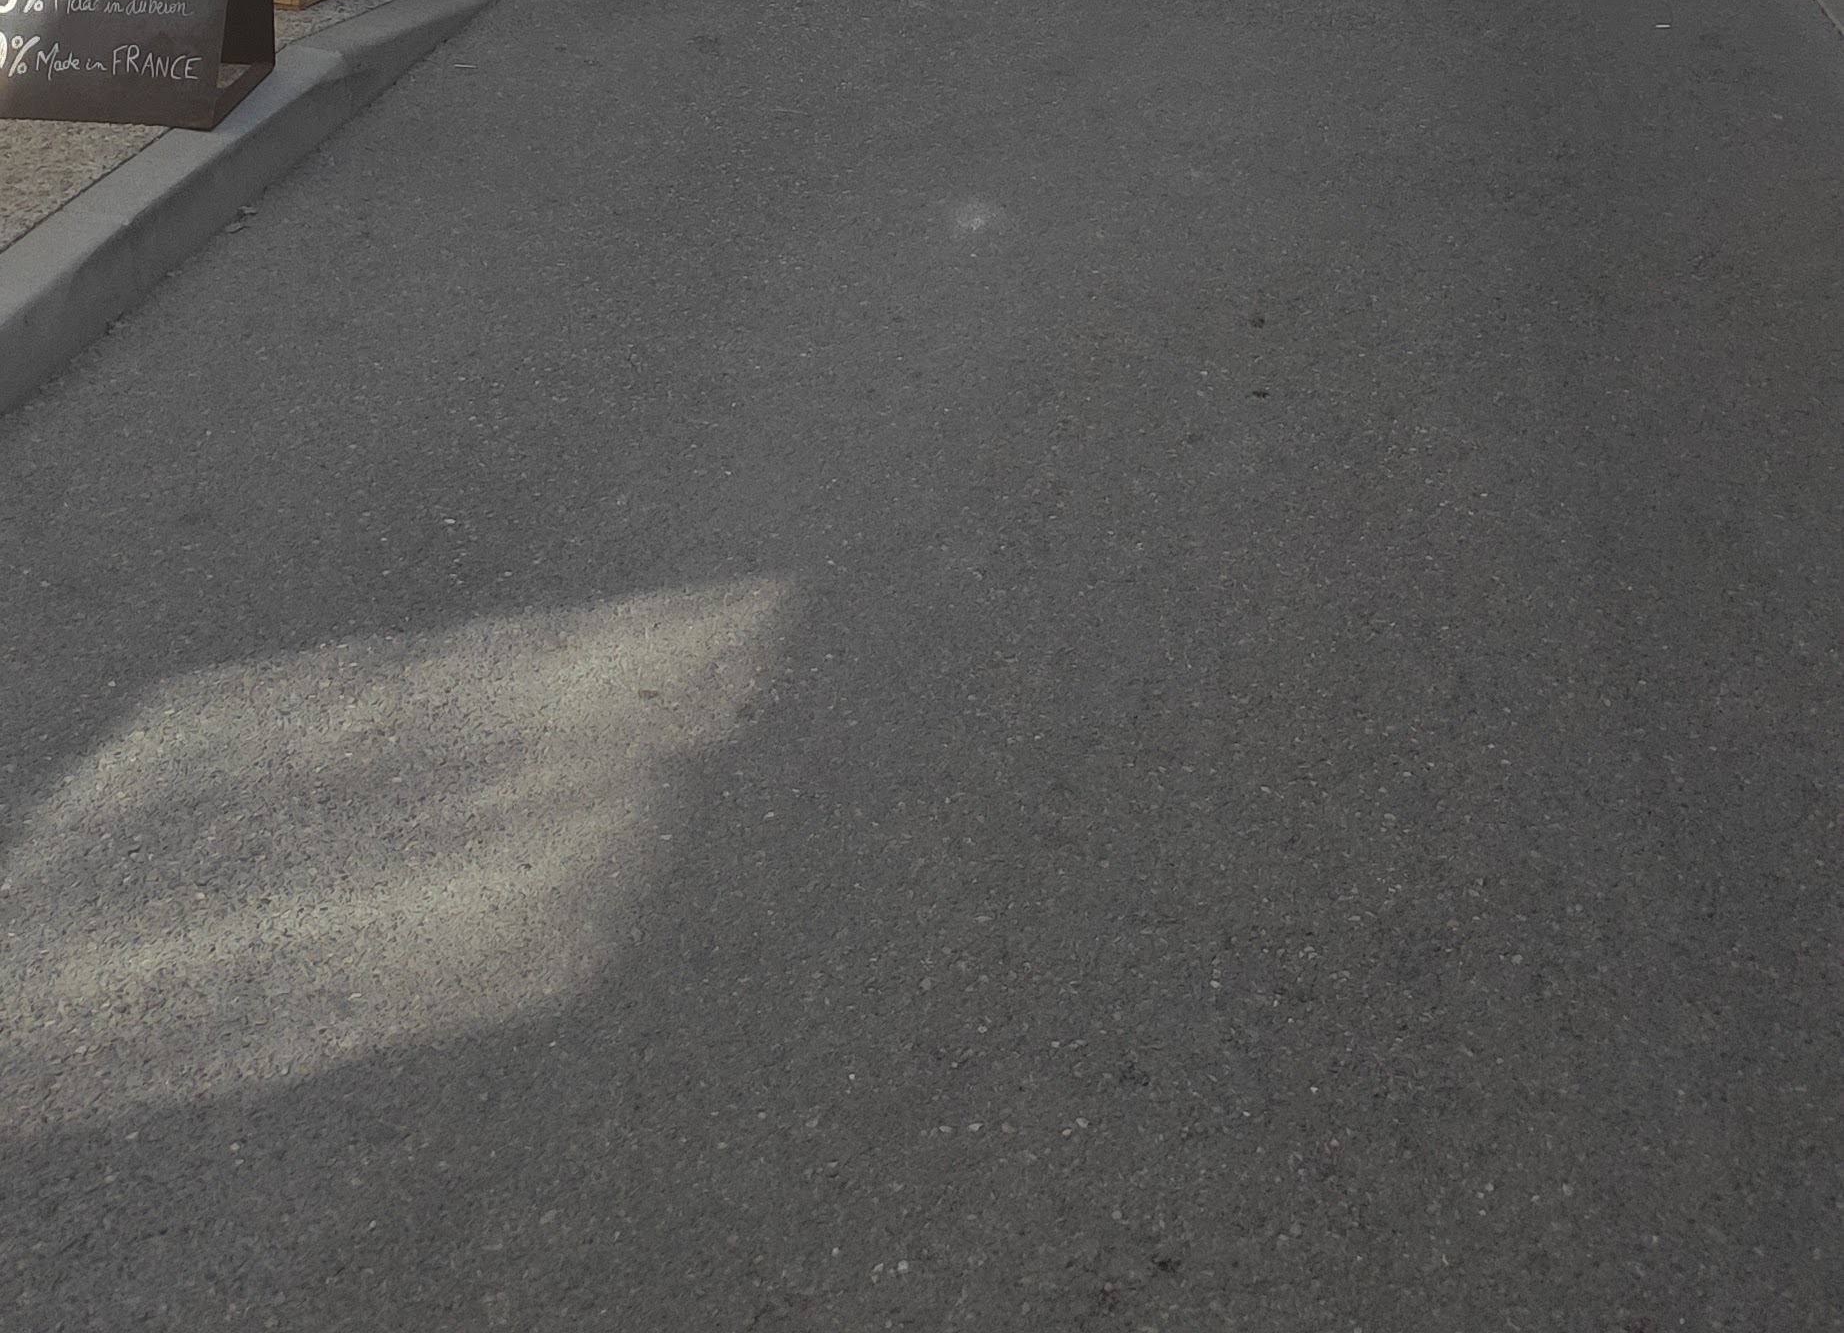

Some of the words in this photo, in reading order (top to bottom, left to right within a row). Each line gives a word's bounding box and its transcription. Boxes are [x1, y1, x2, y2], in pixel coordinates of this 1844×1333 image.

[36, 43, 80, 81] Made
[86, 57, 107, 71] in
[112, 44, 202, 80] FRANCE
